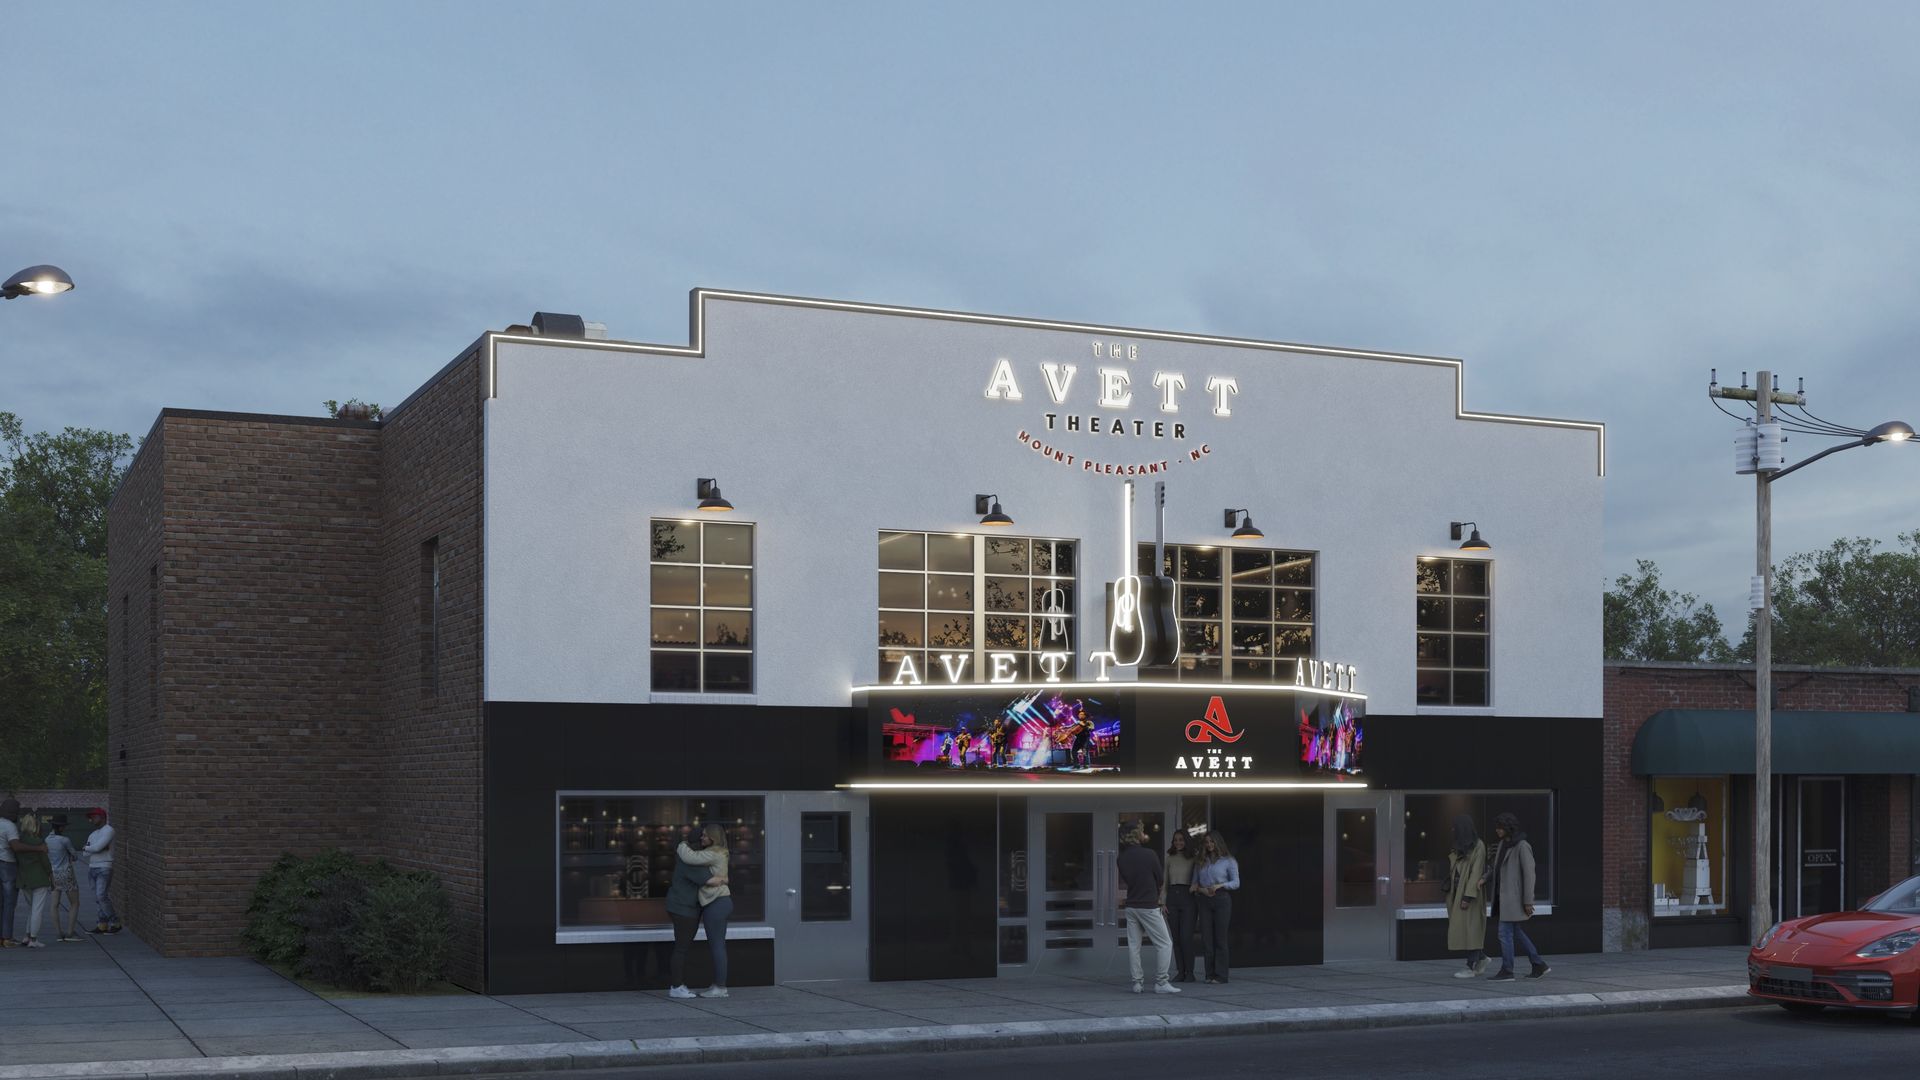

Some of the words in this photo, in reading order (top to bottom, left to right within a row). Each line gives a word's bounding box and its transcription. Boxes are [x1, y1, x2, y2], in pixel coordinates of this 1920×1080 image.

[1093, 341, 1139, 359] THE
[985, 359, 1239, 416] AVETT
[1045, 413, 1186, 439] THEATER
[1018, 430, 1076, 466] MOUNT
[1084, 460, 1168, 475] PLEASANT
[1190, 444, 1211, 463] NC
[893, 650, 1118, 686] AVETT
[1294, 656, 1358, 692] AVETT
[1175, 756, 1253, 769] AVETT
